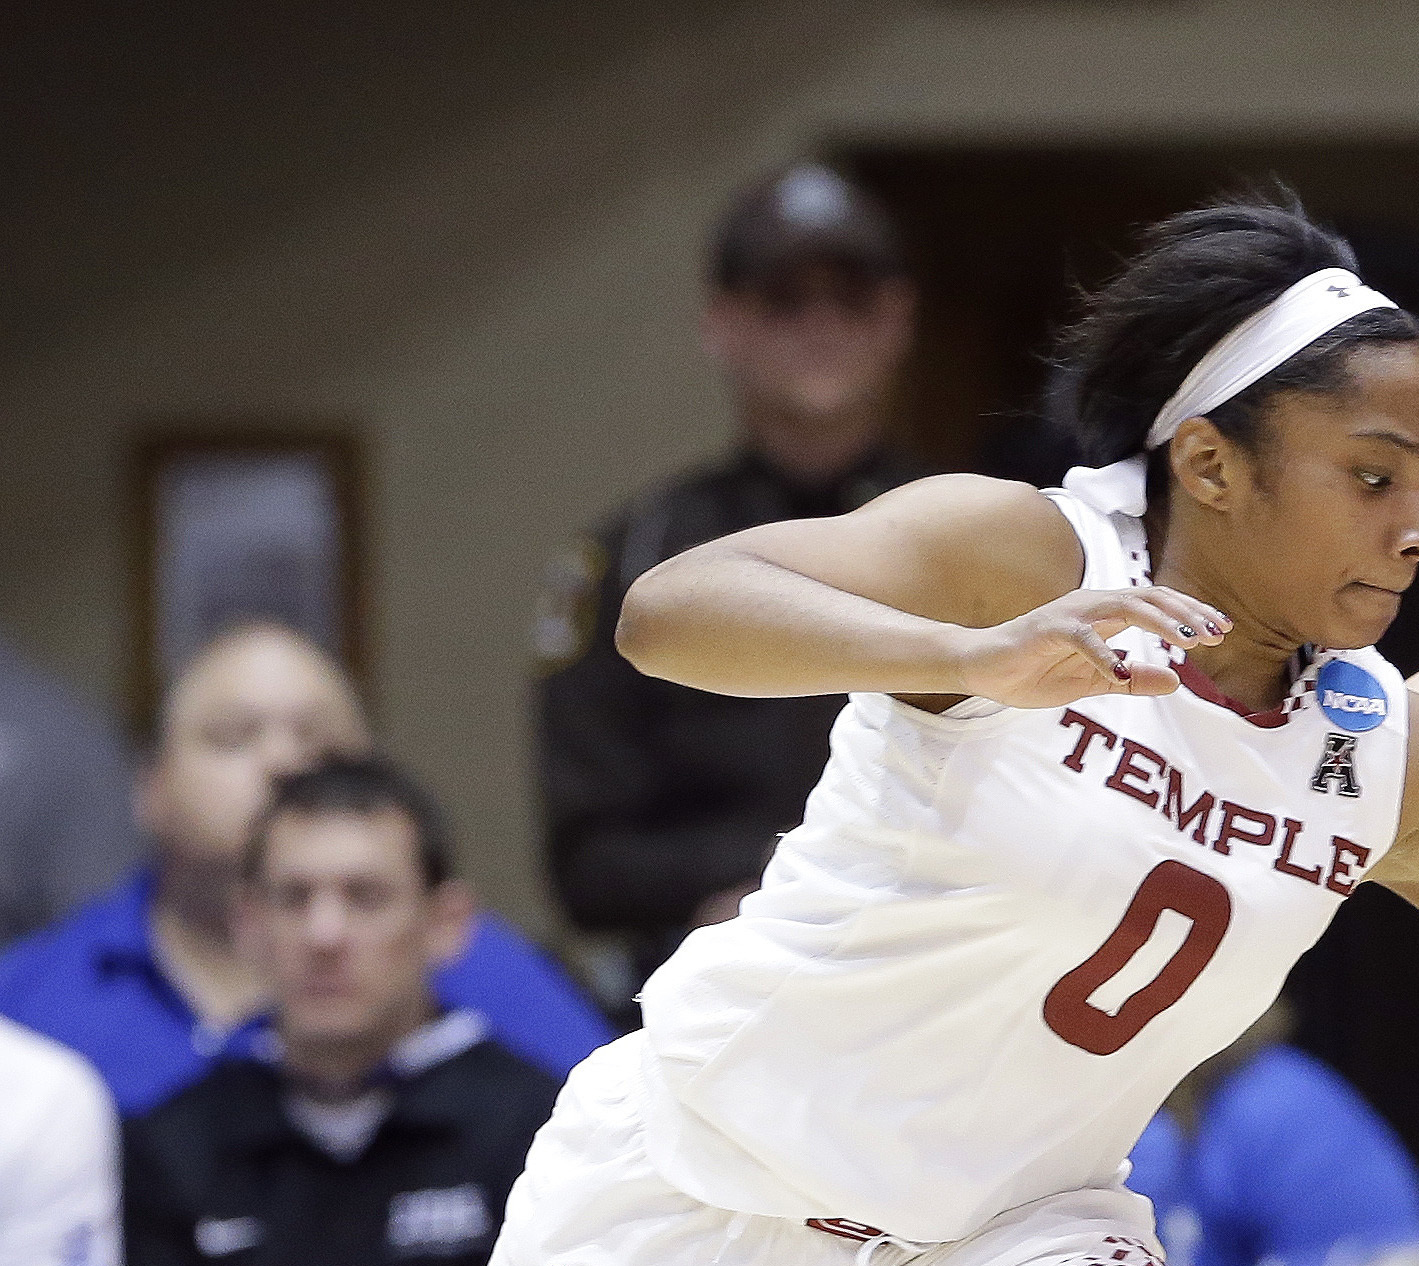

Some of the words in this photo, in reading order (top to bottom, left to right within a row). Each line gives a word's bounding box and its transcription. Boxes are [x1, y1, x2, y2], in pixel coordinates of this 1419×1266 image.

[1322, 689, 1387, 716] NCAA
[1060, 708, 1371, 897] TEMPLE
[1043, 859, 1232, 1056] 0
